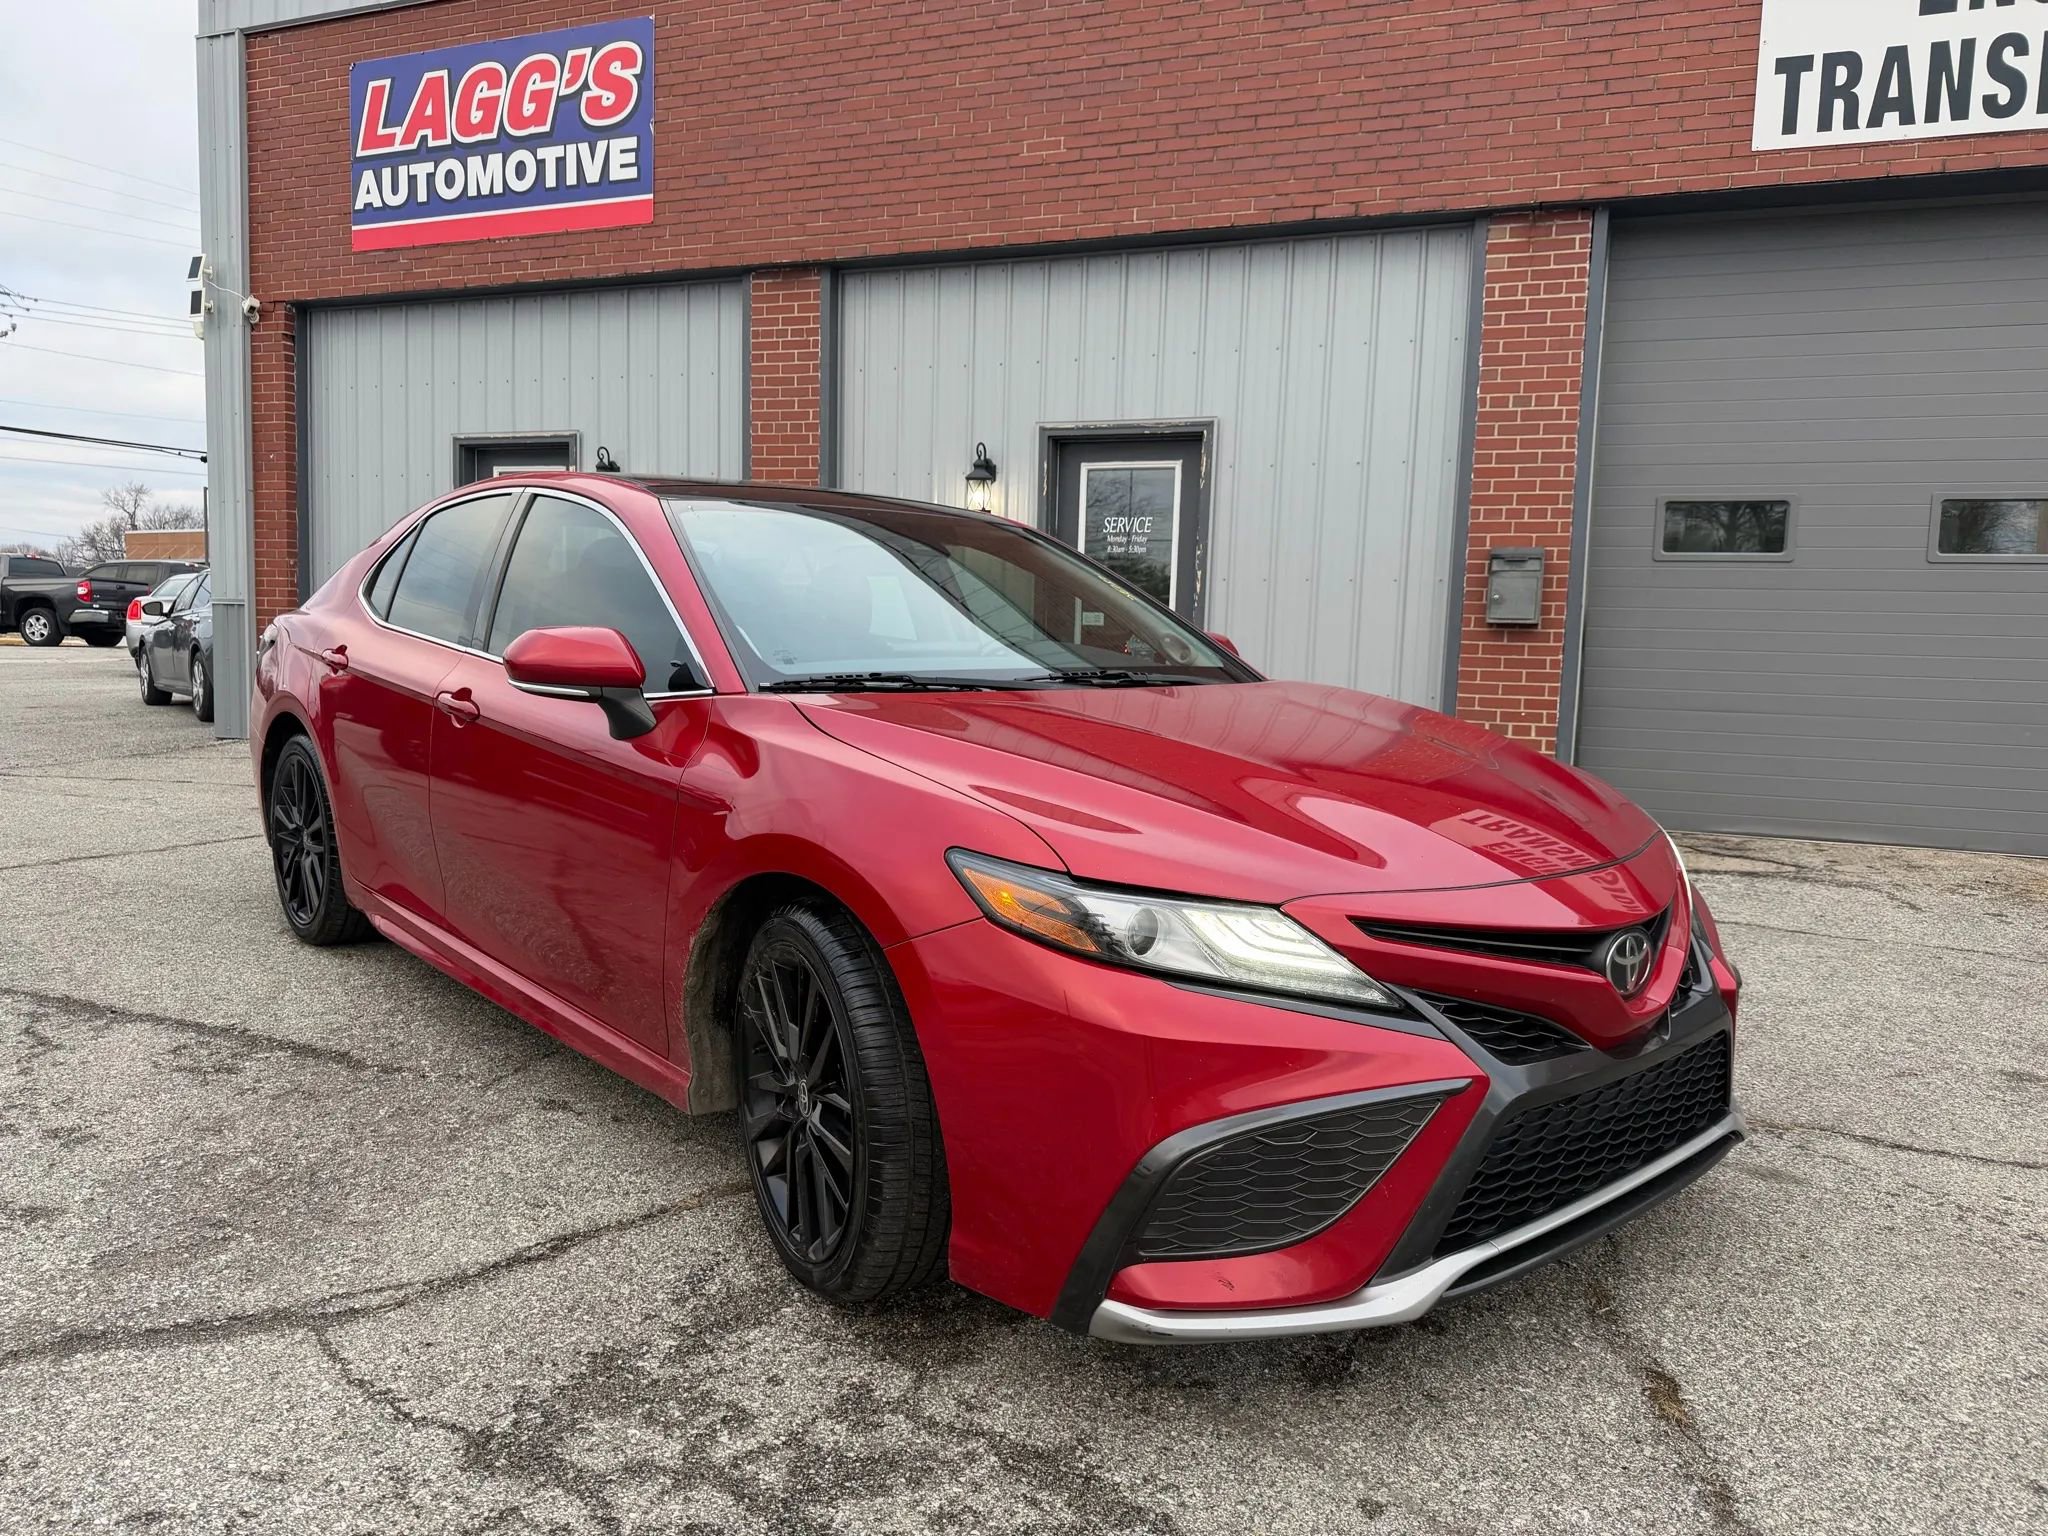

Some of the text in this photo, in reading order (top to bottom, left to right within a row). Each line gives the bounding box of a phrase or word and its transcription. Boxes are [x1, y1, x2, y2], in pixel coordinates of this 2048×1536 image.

[356, 41, 643, 157] LAGG'S
[1774, 31, 2048, 136] TRANS
[354, 136, 638, 211] AUTOMOTIVE
[1103, 516, 1153, 533] SERVICE
[1107, 534, 1127, 544] Monday
[1131, 534, 1148, 544] Friday
